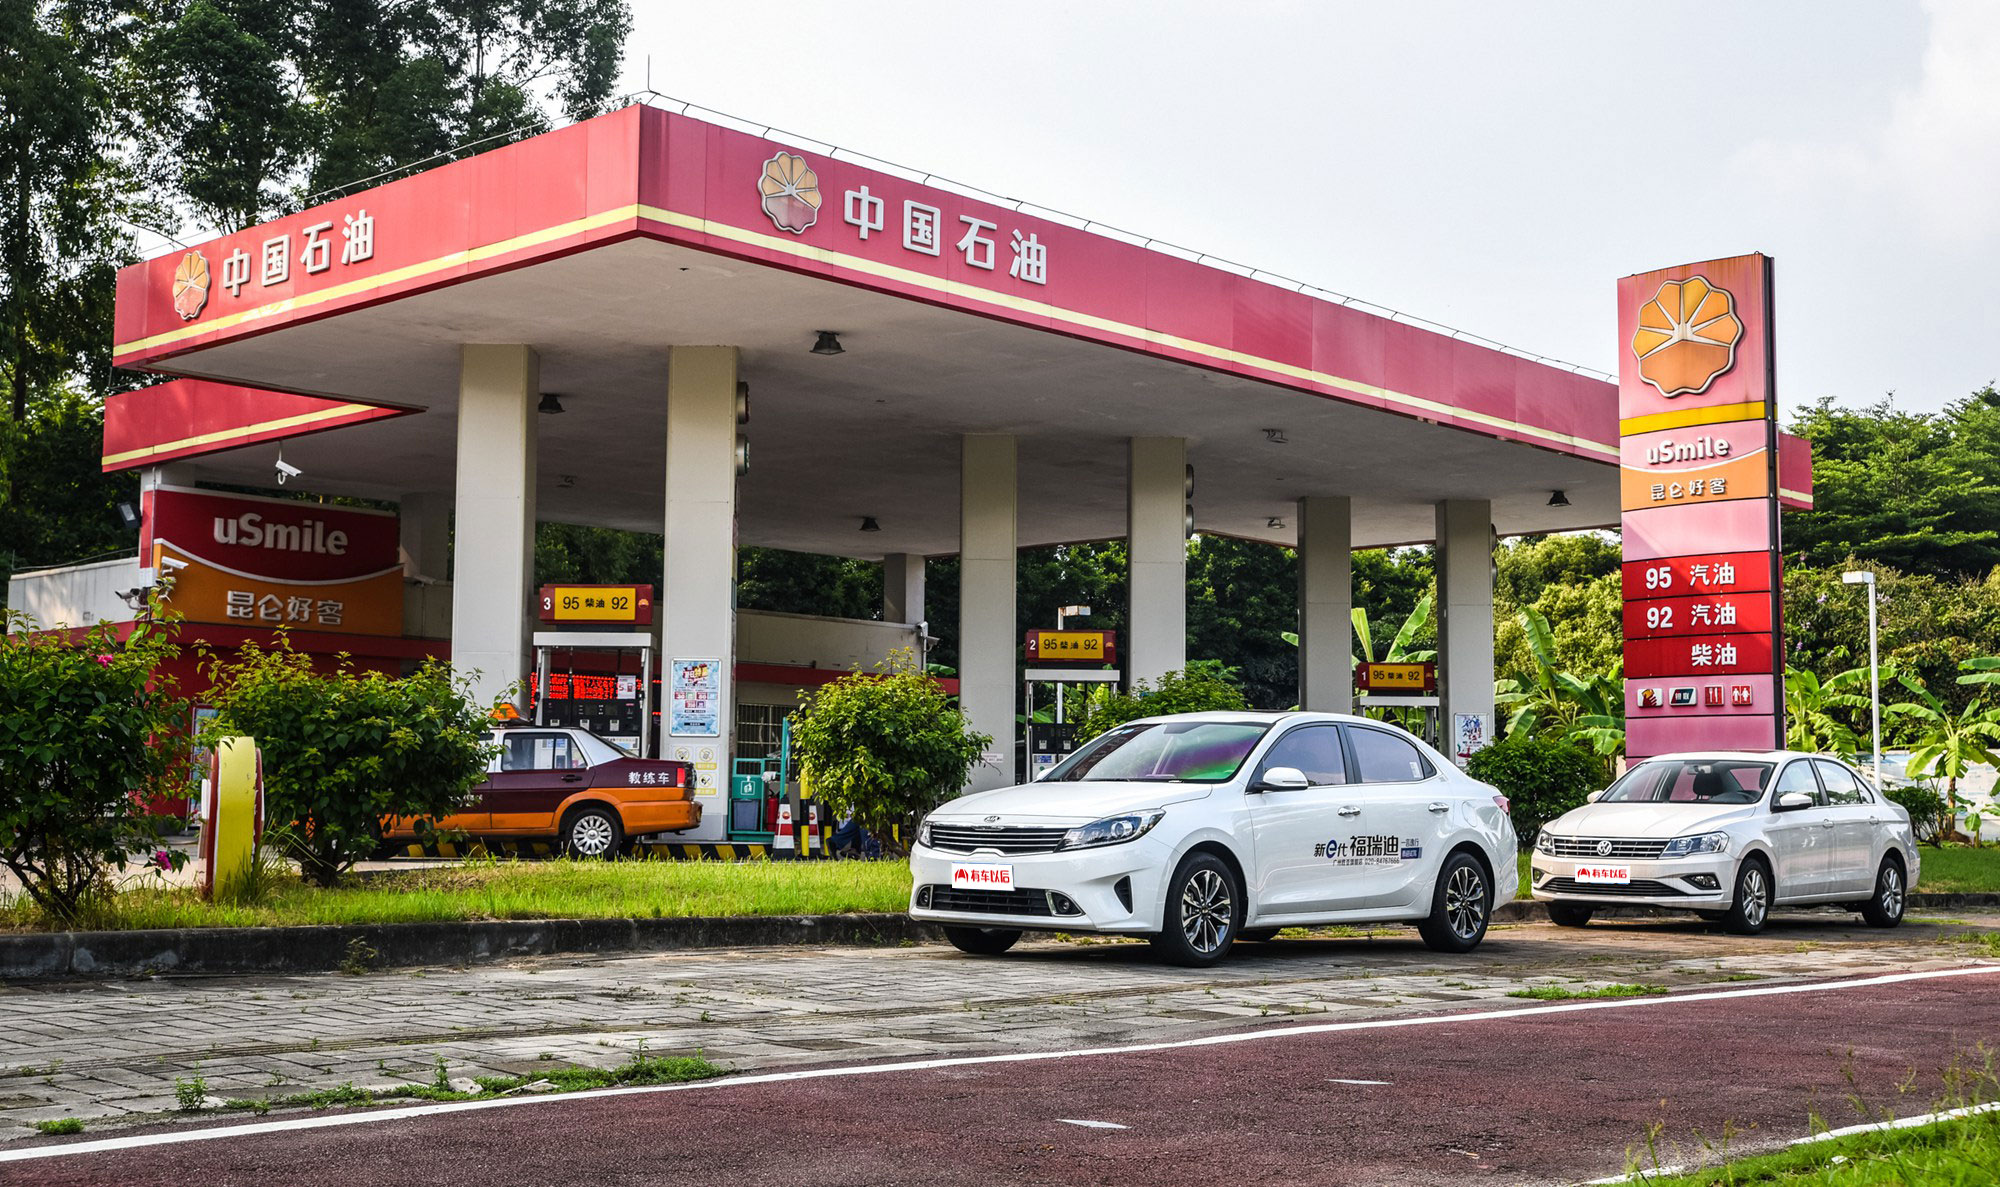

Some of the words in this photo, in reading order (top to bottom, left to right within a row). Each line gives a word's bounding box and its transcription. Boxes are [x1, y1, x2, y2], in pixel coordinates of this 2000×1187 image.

[844, 185, 1047, 285] 中国石油
[223, 209, 375, 297] 中国石油
[1646, 436, 1730, 465] uSmile
[1651, 477, 1727, 500] 昆仑好客
[213, 512, 349, 556] uSmile
[1645, 566, 1673, 590] 95
[1689, 562, 1735, 587] 汽油
[226, 589, 344, 626] 昆仑好客
[543, 596, 552, 611] 3
[562, 596, 580, 610] 95
[584, 598, 606, 609] 柴油
[611, 596, 629, 610] 92
[1646, 606, 1674, 629] 92
[1690, 602, 1737, 627] 汽油
[1029, 639, 1036, 651] 2
[1043, 638, 1058, 650] 95
[1083, 639, 1098, 650] 92
[1691, 642, 1738, 667] 柴油
[1361, 671, 1367, 681] 1
[1372, 670, 1385, 680] 95
[1407, 671, 1420, 681] 92
[628, 771, 670, 785] 教练车
